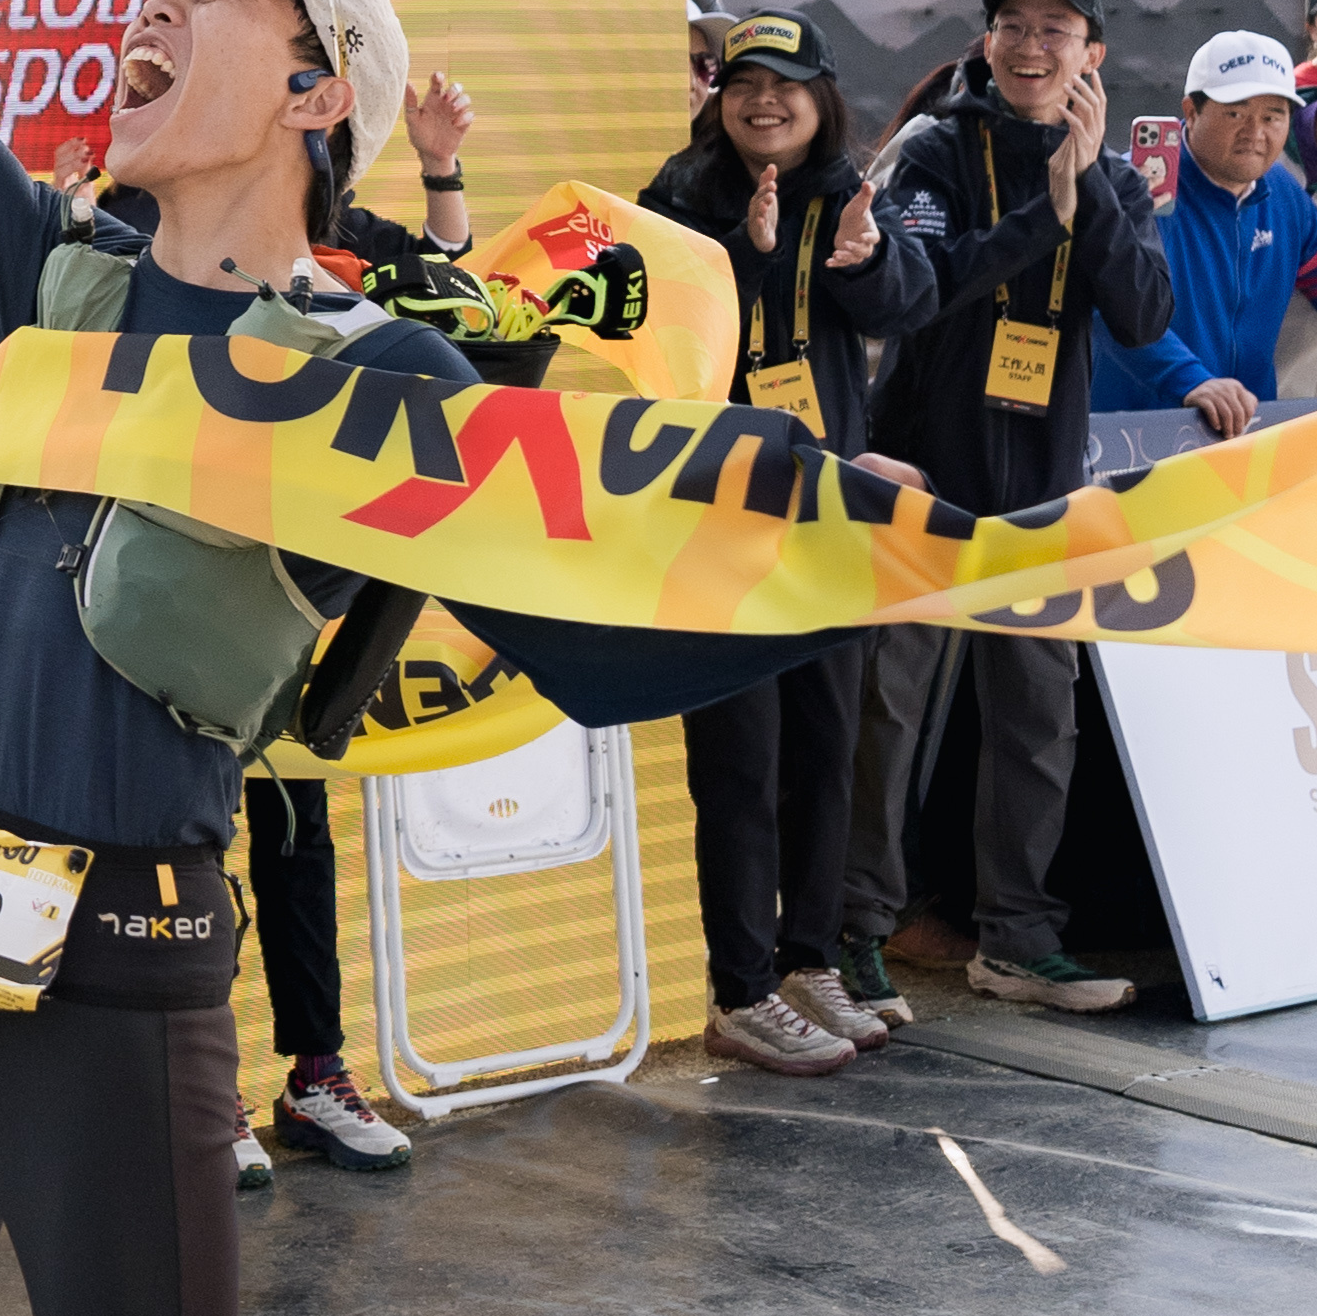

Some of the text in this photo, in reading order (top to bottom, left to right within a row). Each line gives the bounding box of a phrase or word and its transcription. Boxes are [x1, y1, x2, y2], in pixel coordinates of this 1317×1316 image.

[1219, 55, 1255, 73] DEEP
[621, 270, 642, 332] LEKI
[998, 356, 1046, 376] 工作人员
[1008, 373, 1032, 382] STAFF
[774, 398, 810, 412] 人员
